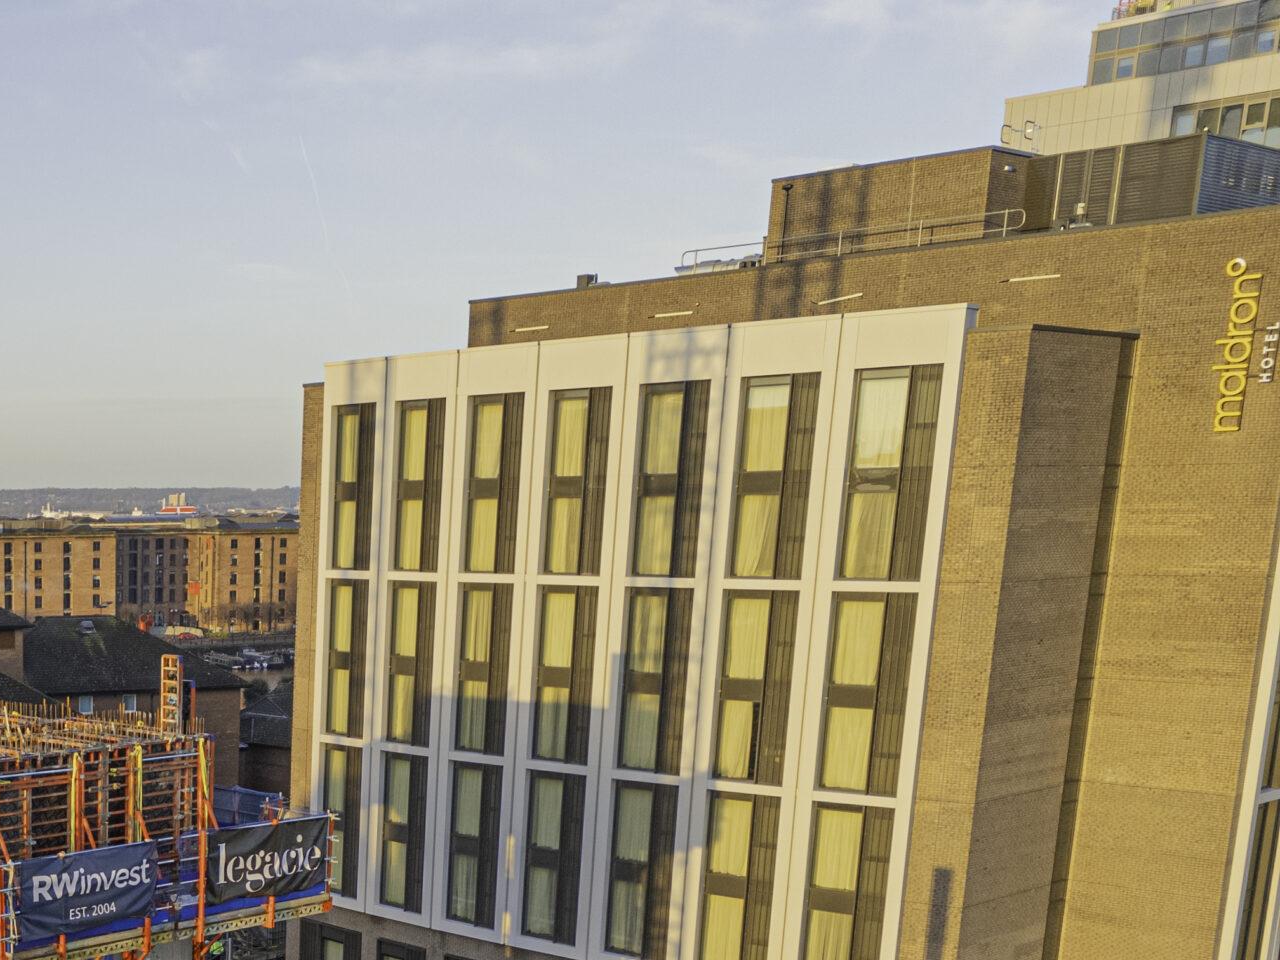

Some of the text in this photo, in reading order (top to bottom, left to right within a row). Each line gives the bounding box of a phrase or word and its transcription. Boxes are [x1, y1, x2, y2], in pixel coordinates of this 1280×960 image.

[1212, 273, 1263, 432] maldron
[1258, 321, 1280, 383] HOTEL
[31, 858, 151, 903] RWinvest
[216, 833, 322, 893] legacie
[69, 901, 117, 920] EST. 2004
